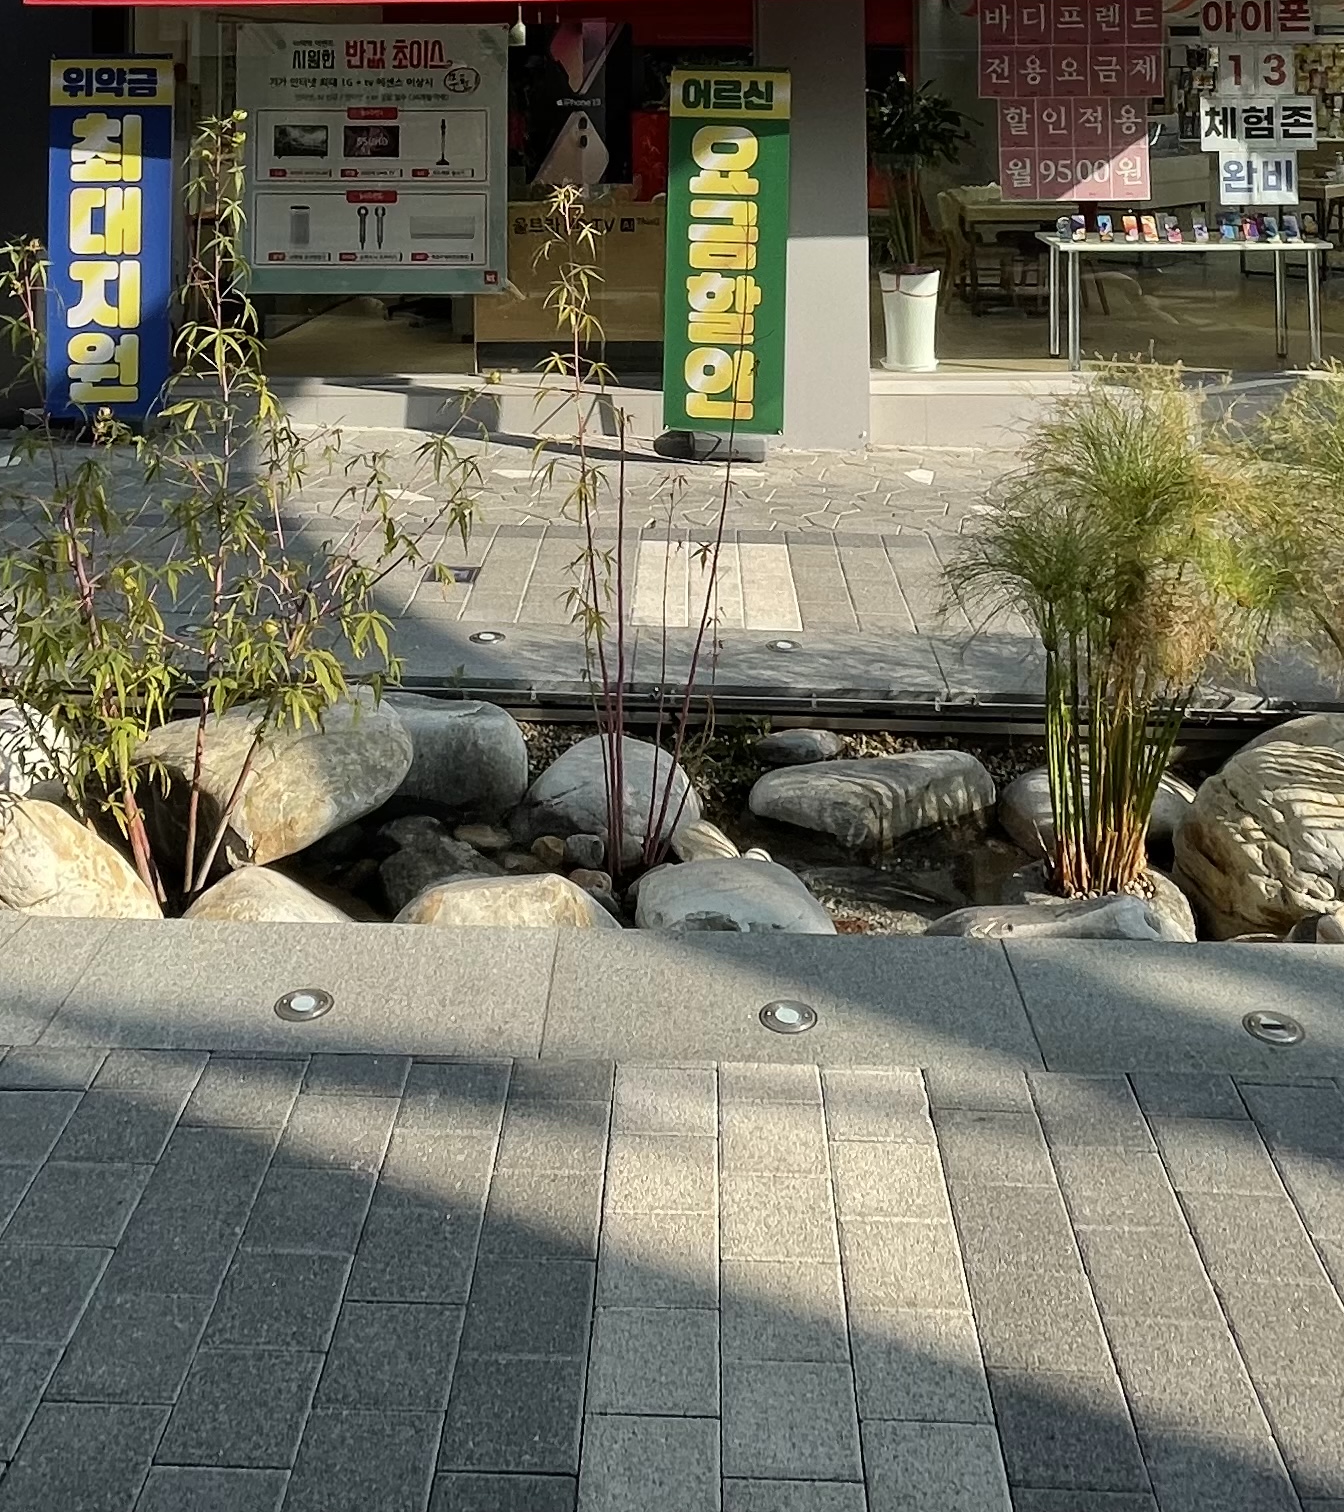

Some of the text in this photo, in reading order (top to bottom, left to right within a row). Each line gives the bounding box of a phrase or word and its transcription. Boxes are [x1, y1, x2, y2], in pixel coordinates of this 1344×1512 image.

[984, 3, 1158, 33] 바디프렌드
[1202, 0, 1311, 33] 아이폰
[292, 39, 453, 69] 시원한 반값 초이스
[984, 55, 1157, 85] 전용요금제
[1228, 53, 1287, 86] 13
[62, 66, 158, 99] 위약금
[682, 79, 775, 112] 어르신
[564, 98, 591, 106] iPhone
[1003, 105, 1142, 136] 할인적용
[1204, 106, 1314, 140] 체험존
[1005, 157, 1144, 188] 월9500원
[1222, 159, 1293, 193] 완비
[66, 112, 143, 404] 최대지원
[683, 123, 761, 422] 요금할인
